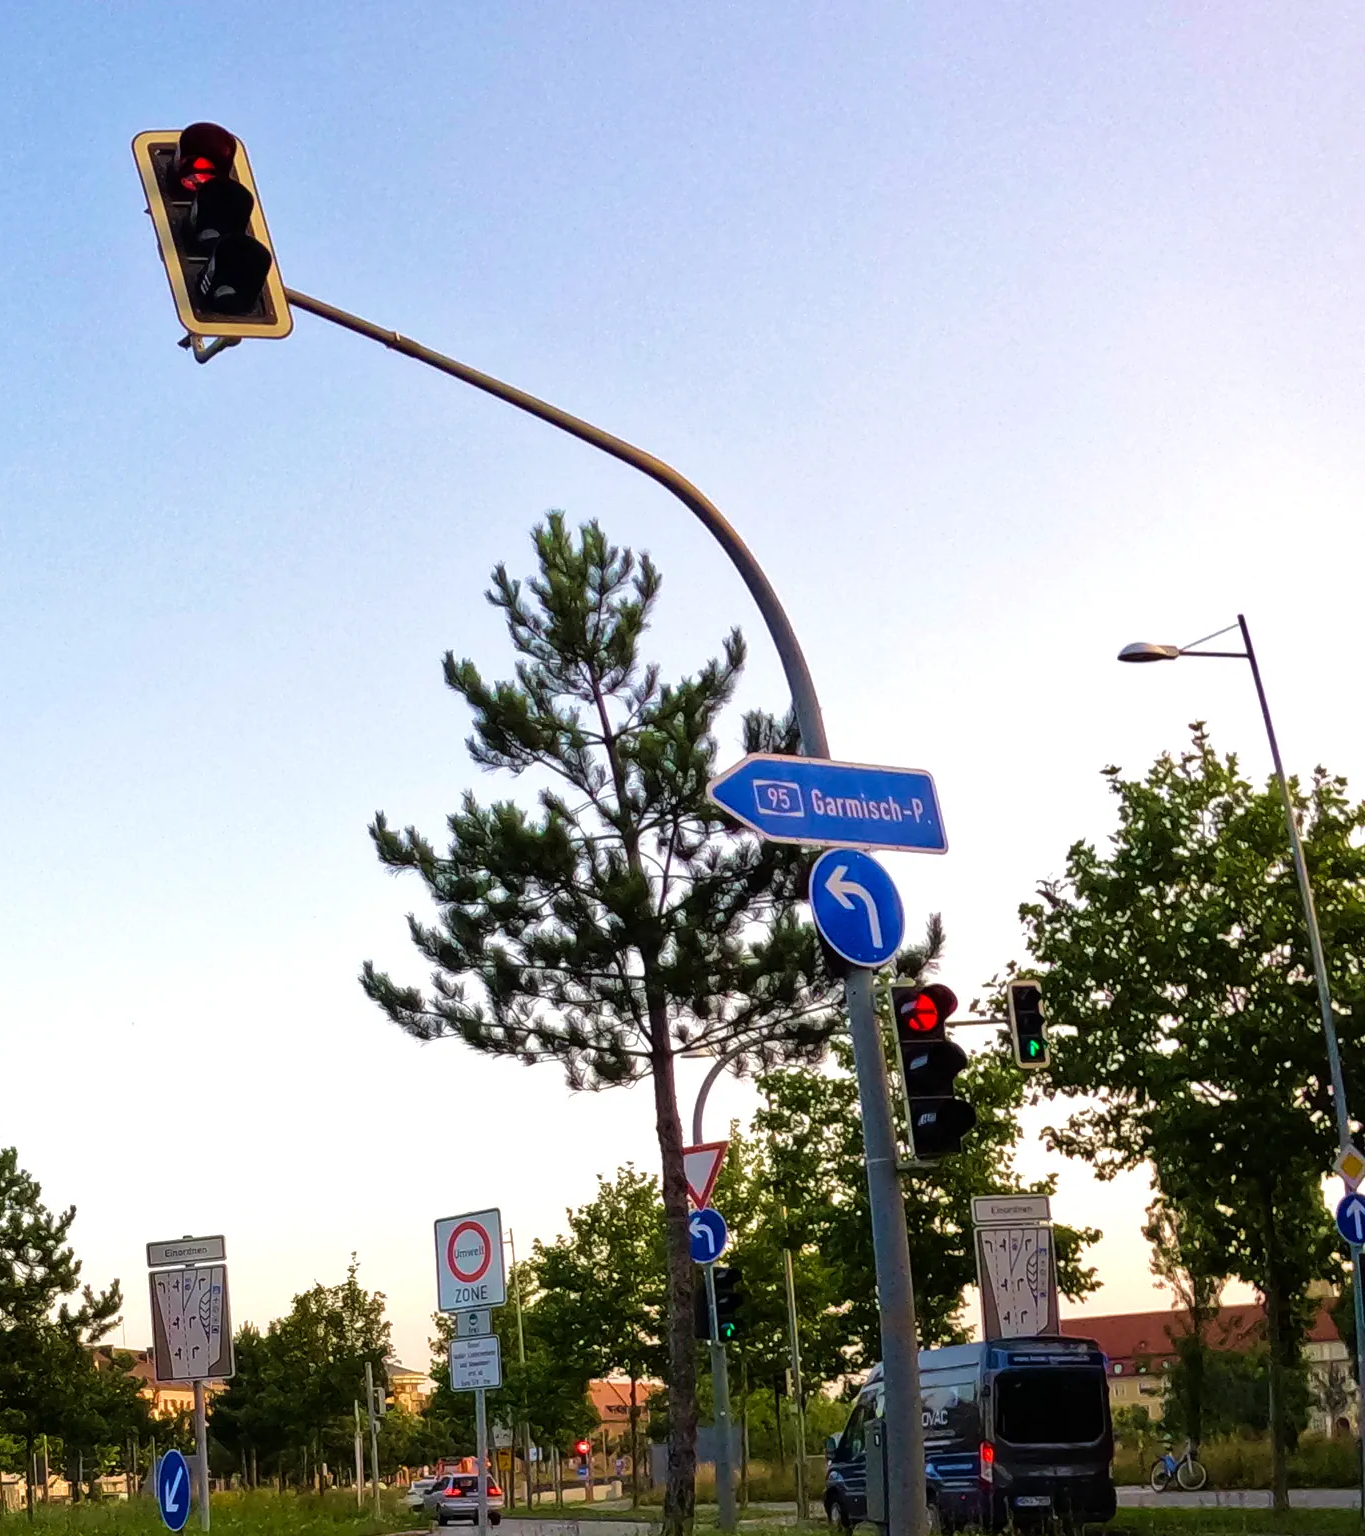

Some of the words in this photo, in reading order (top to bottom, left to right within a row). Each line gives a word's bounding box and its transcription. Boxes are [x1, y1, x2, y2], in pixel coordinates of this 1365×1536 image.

[767, 787, 791, 809] 95
[810, 788, 933, 824] Garmisch-P.
[164, 1247, 208, 1257] Einordnen
[454, 1245, 484, 1259] Umwelt
[455, 1284, 488, 1303] ZONE
